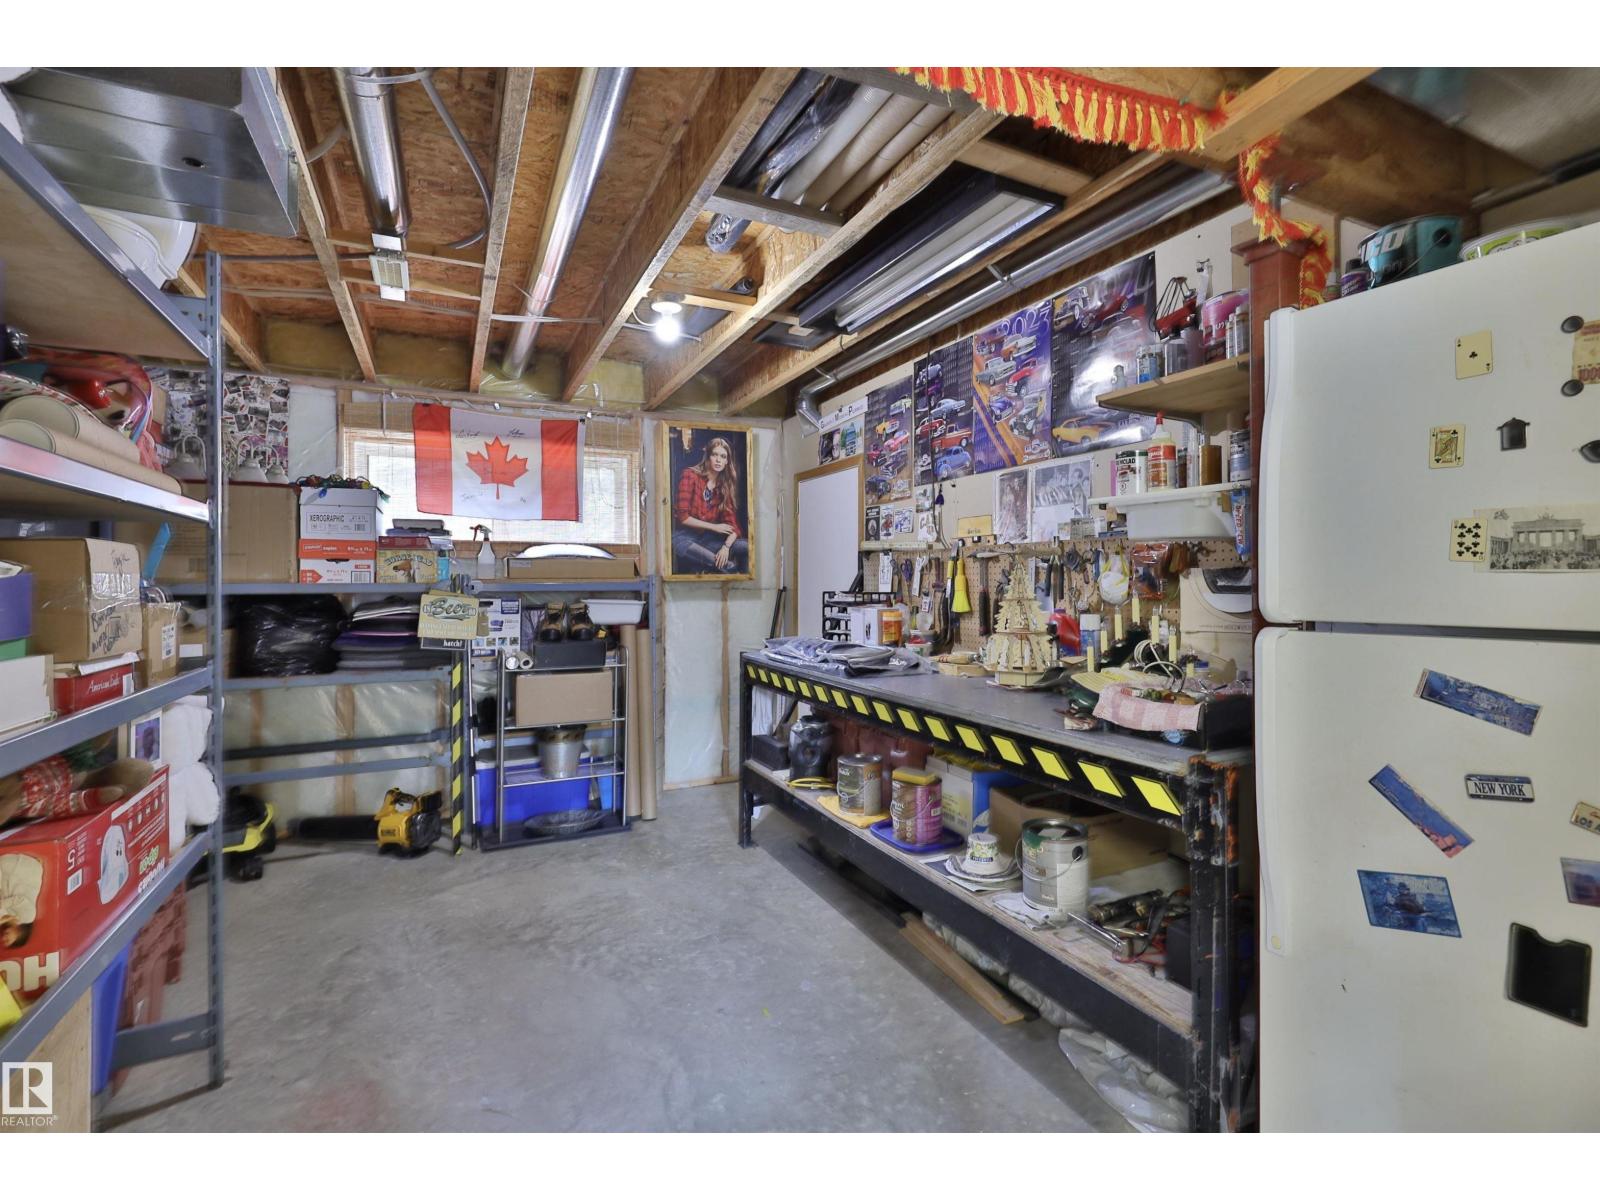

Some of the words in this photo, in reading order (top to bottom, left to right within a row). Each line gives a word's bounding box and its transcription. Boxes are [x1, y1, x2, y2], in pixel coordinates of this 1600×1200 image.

[1000, 306, 1050, 337] 2023
[309, 514, 345, 523] XEROGRAPHIC
[430, 597, 469, 618] Beer
[443, 639, 462, 647] hatch!
[1473, 781, 1496, 795] NEW
[1499, 783, 1526, 797] YORK
[1574, 814, 1593, 829] LOS
